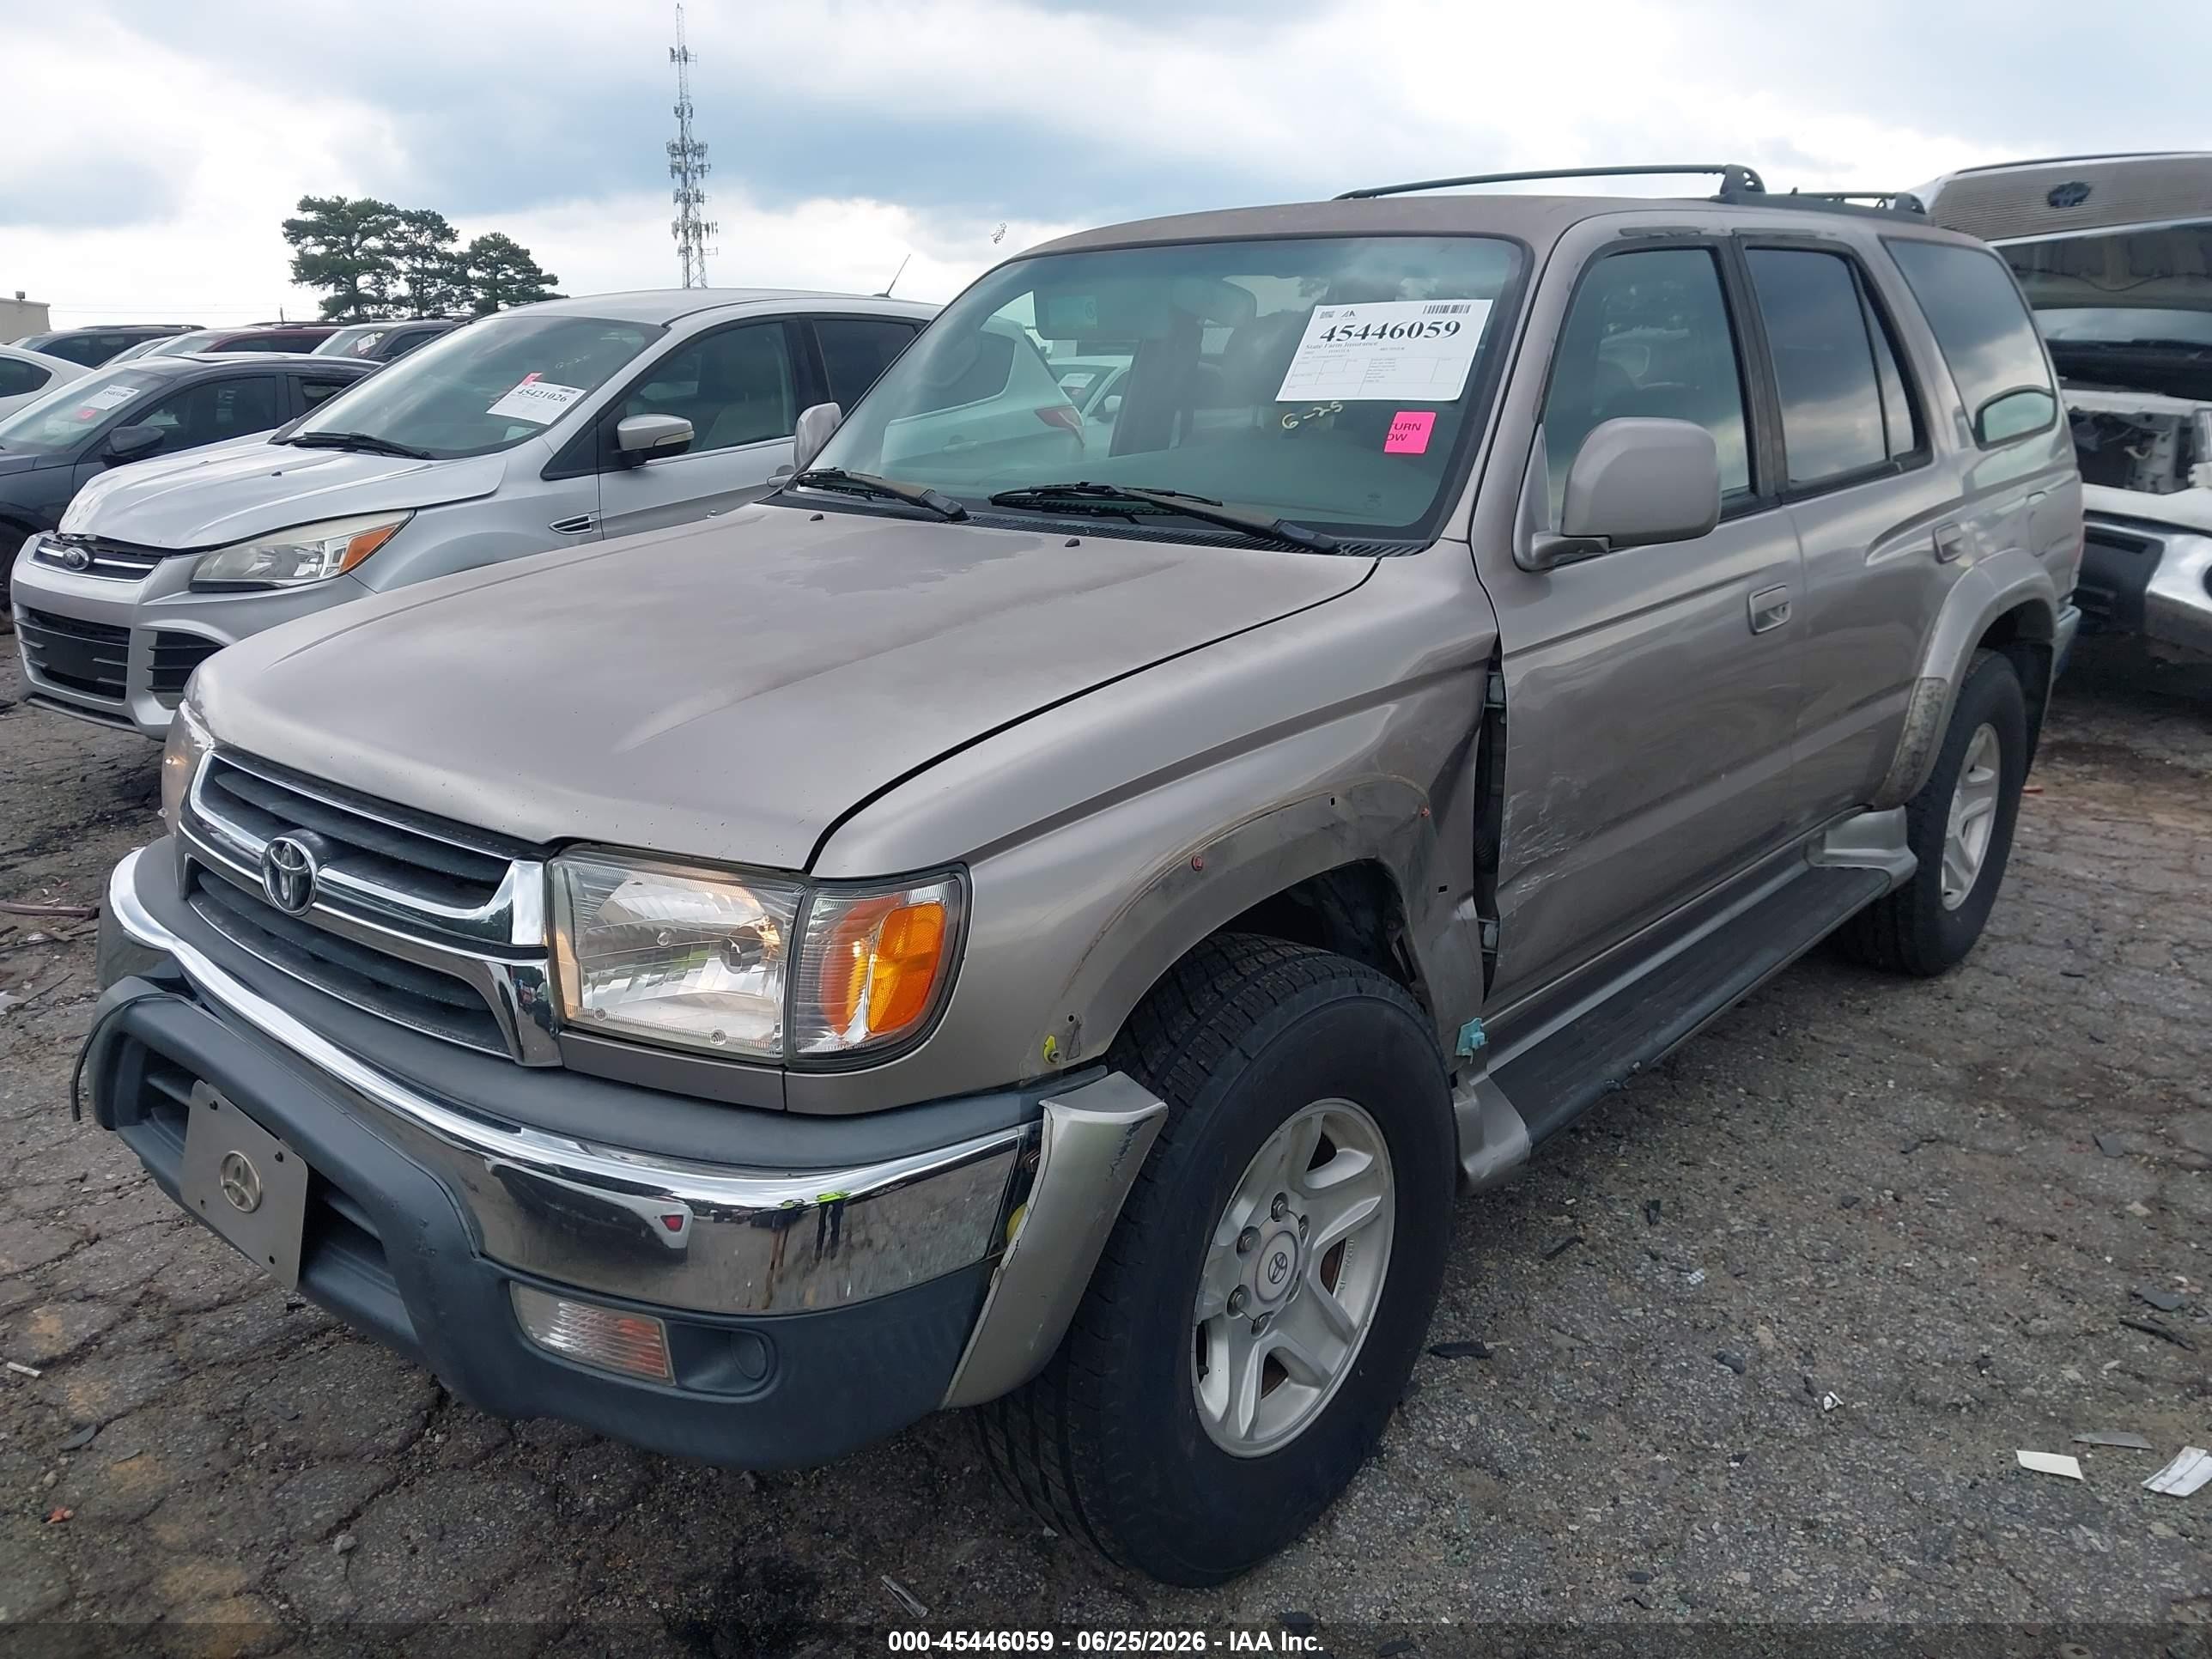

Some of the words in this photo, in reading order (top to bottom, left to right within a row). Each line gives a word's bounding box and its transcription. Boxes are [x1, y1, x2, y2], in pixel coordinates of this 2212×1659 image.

[1319, 320, 1462, 343] 45446059
[517, 388, 568, 403] 45421026
[1282, 401, 1344, 429] 6-25
[1393, 422, 1422, 431] URN
